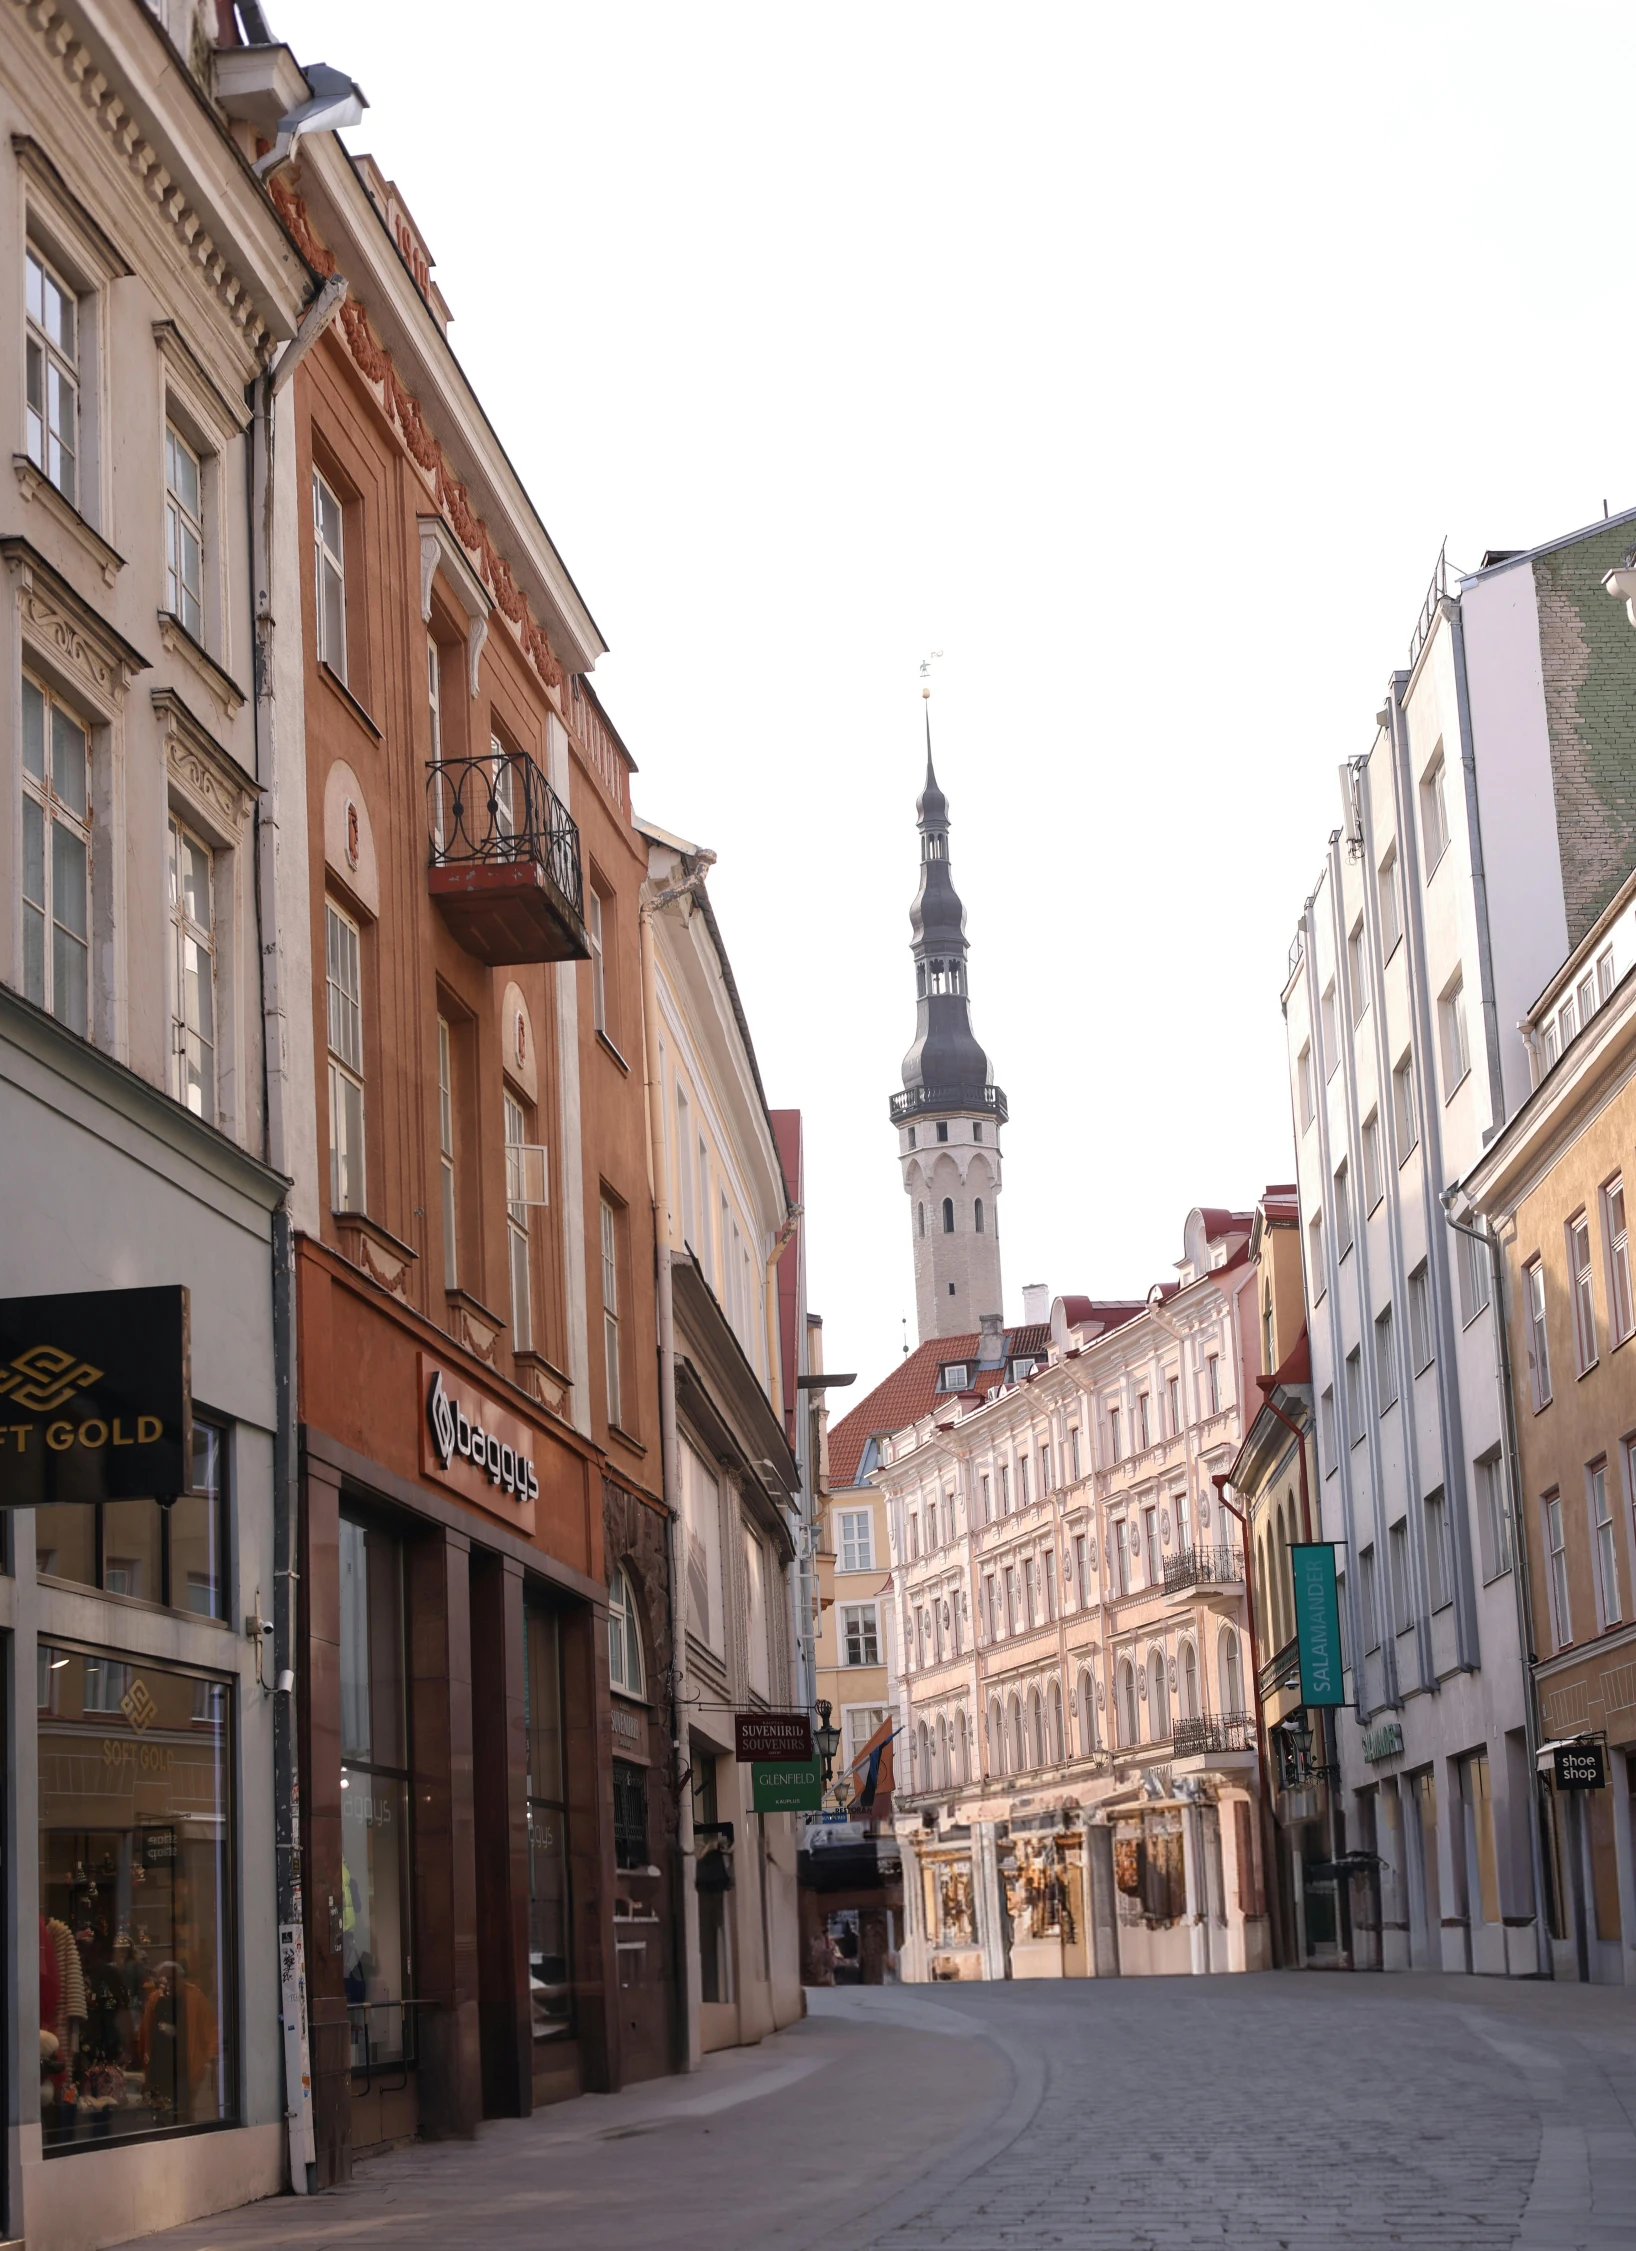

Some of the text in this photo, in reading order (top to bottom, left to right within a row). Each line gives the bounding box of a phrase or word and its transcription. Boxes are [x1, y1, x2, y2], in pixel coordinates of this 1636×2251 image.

[45, 1415, 164, 1451] GOLD
[455, 1399, 540, 1502] baggys
[1305, 1560, 1331, 1692] SALAMANDER
[742, 1725, 804, 1737] SUVENIIRID
[742, 1738, 805, 1751] SOUVENIRS
[102, 1739, 175, 1771] SOFT GOLD
[759, 1773, 815, 1786] GLENFIELD
[1563, 1767, 1597, 1781] shop
[835, 1806, 873, 1815] RESTORAN
